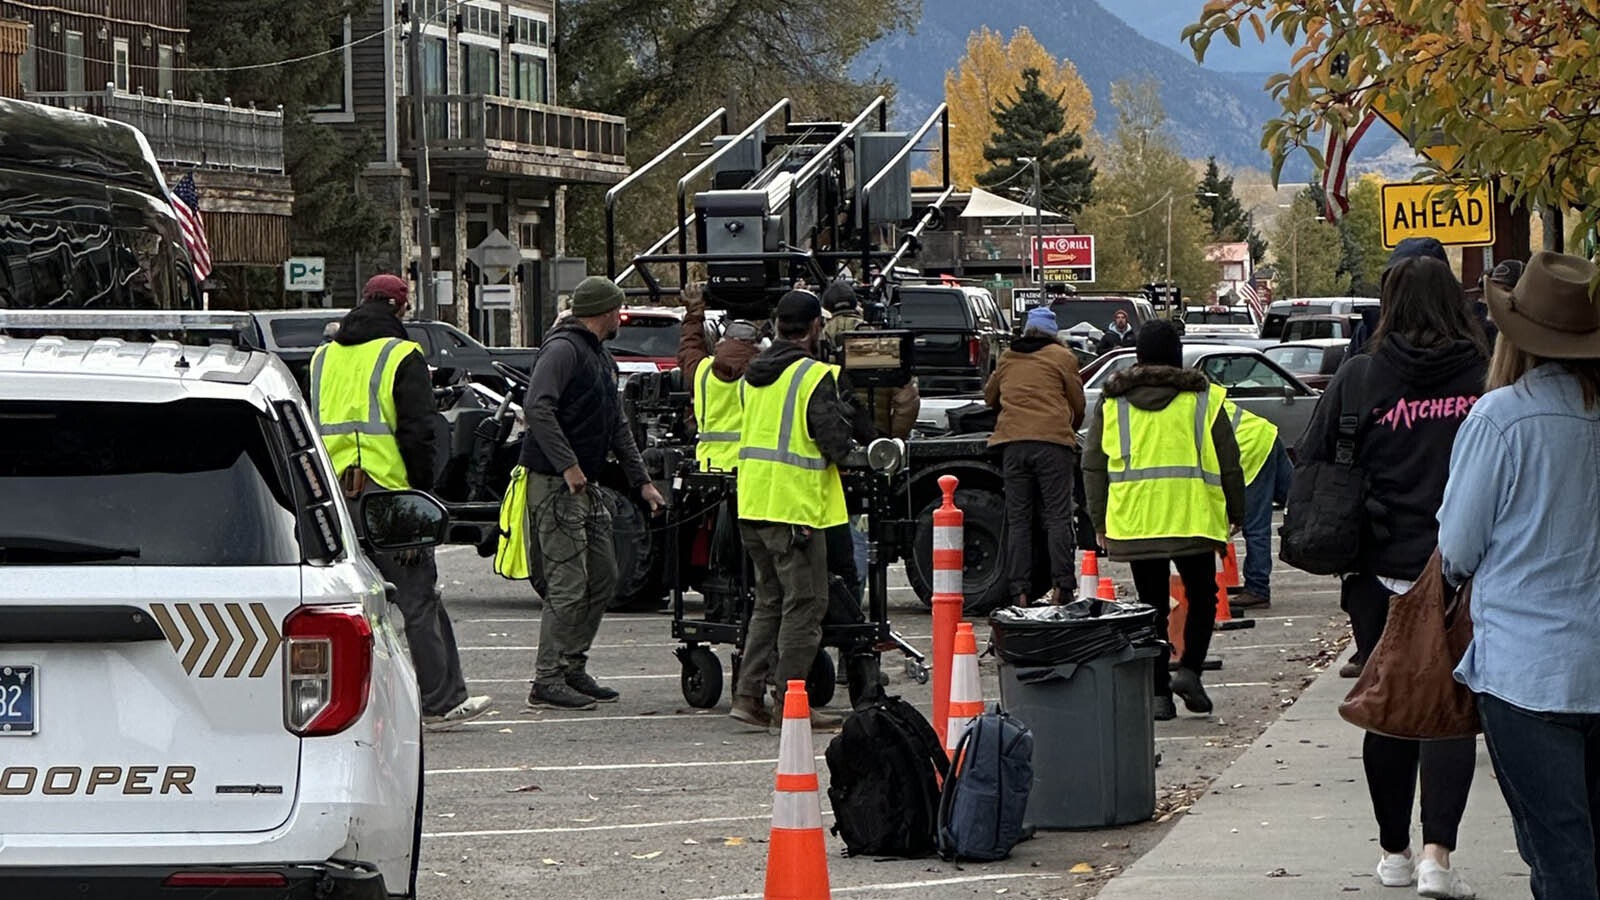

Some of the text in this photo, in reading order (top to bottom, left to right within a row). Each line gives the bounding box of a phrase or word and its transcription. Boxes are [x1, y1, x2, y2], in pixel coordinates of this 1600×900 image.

[1393, 198, 1483, 229] AHEAD
[290, 263, 307, 284] P
[0, 766, 197, 795] OOPER
